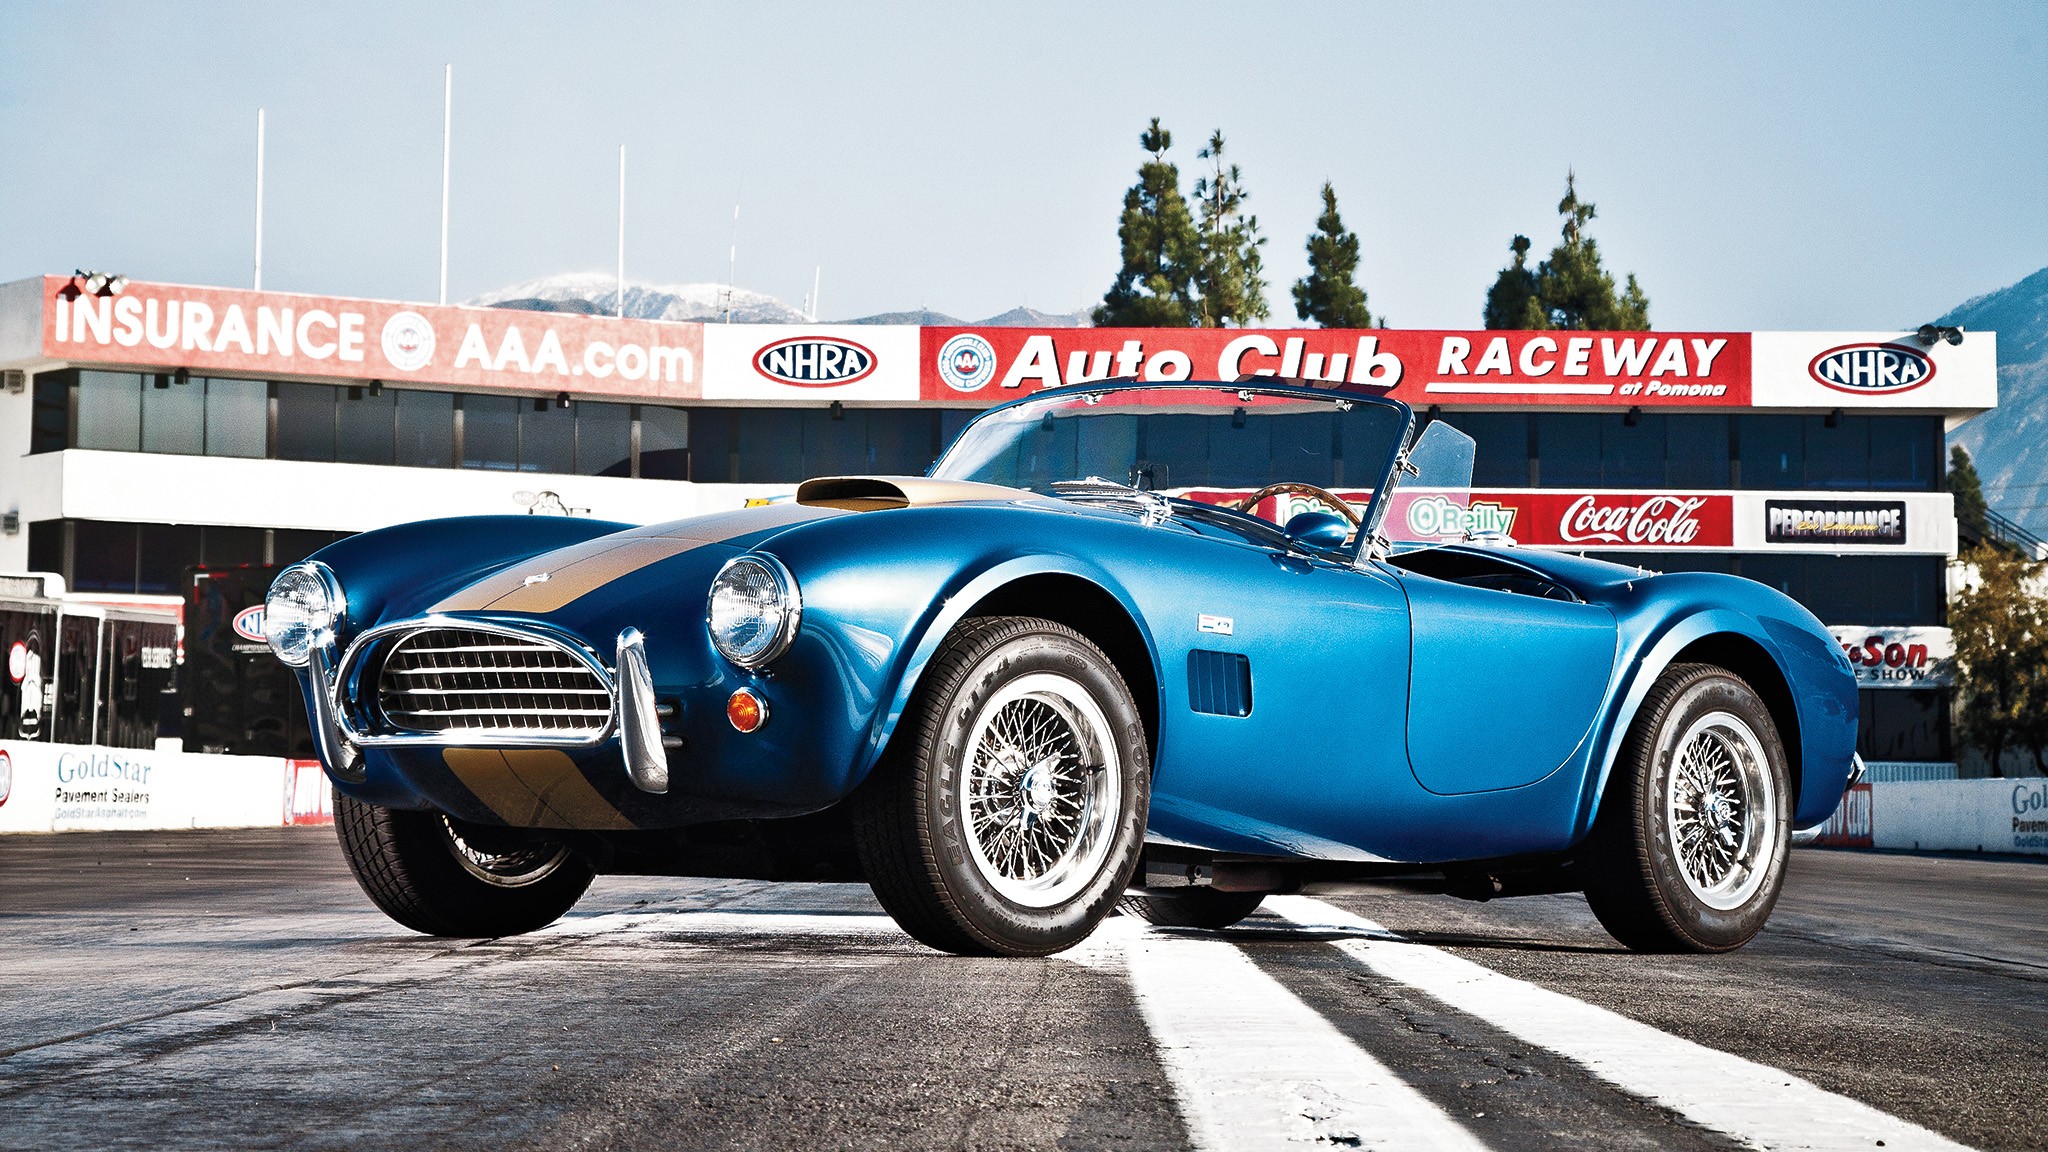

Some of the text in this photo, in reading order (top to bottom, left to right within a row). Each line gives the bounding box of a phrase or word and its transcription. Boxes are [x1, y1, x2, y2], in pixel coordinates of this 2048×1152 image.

[55, 294, 365, 362] INSURANCE
[453, 323, 693, 383] AAA.com
[769, 343, 862, 379] NHRA
[1000, 335, 1193, 388] Auto
[1218, 334, 1403, 388] Club
[1437, 336, 1727, 377] RACEWAY
[1827, 351, 1921, 387] NHRA
[1619, 380, 1727, 397] at Pomona
[1412, 501, 1509, 533] O'Reilly
[1560, 495, 1708, 543] Coca-Cola
[1770, 507, 1902, 536] PERFORMANCE
[1870, 669, 1925, 681] SHOW
[58, 752, 151, 785] GoldStar
[55, 787, 150, 804] Pavement Sealers
[2012, 784, 2048, 815] Gol
